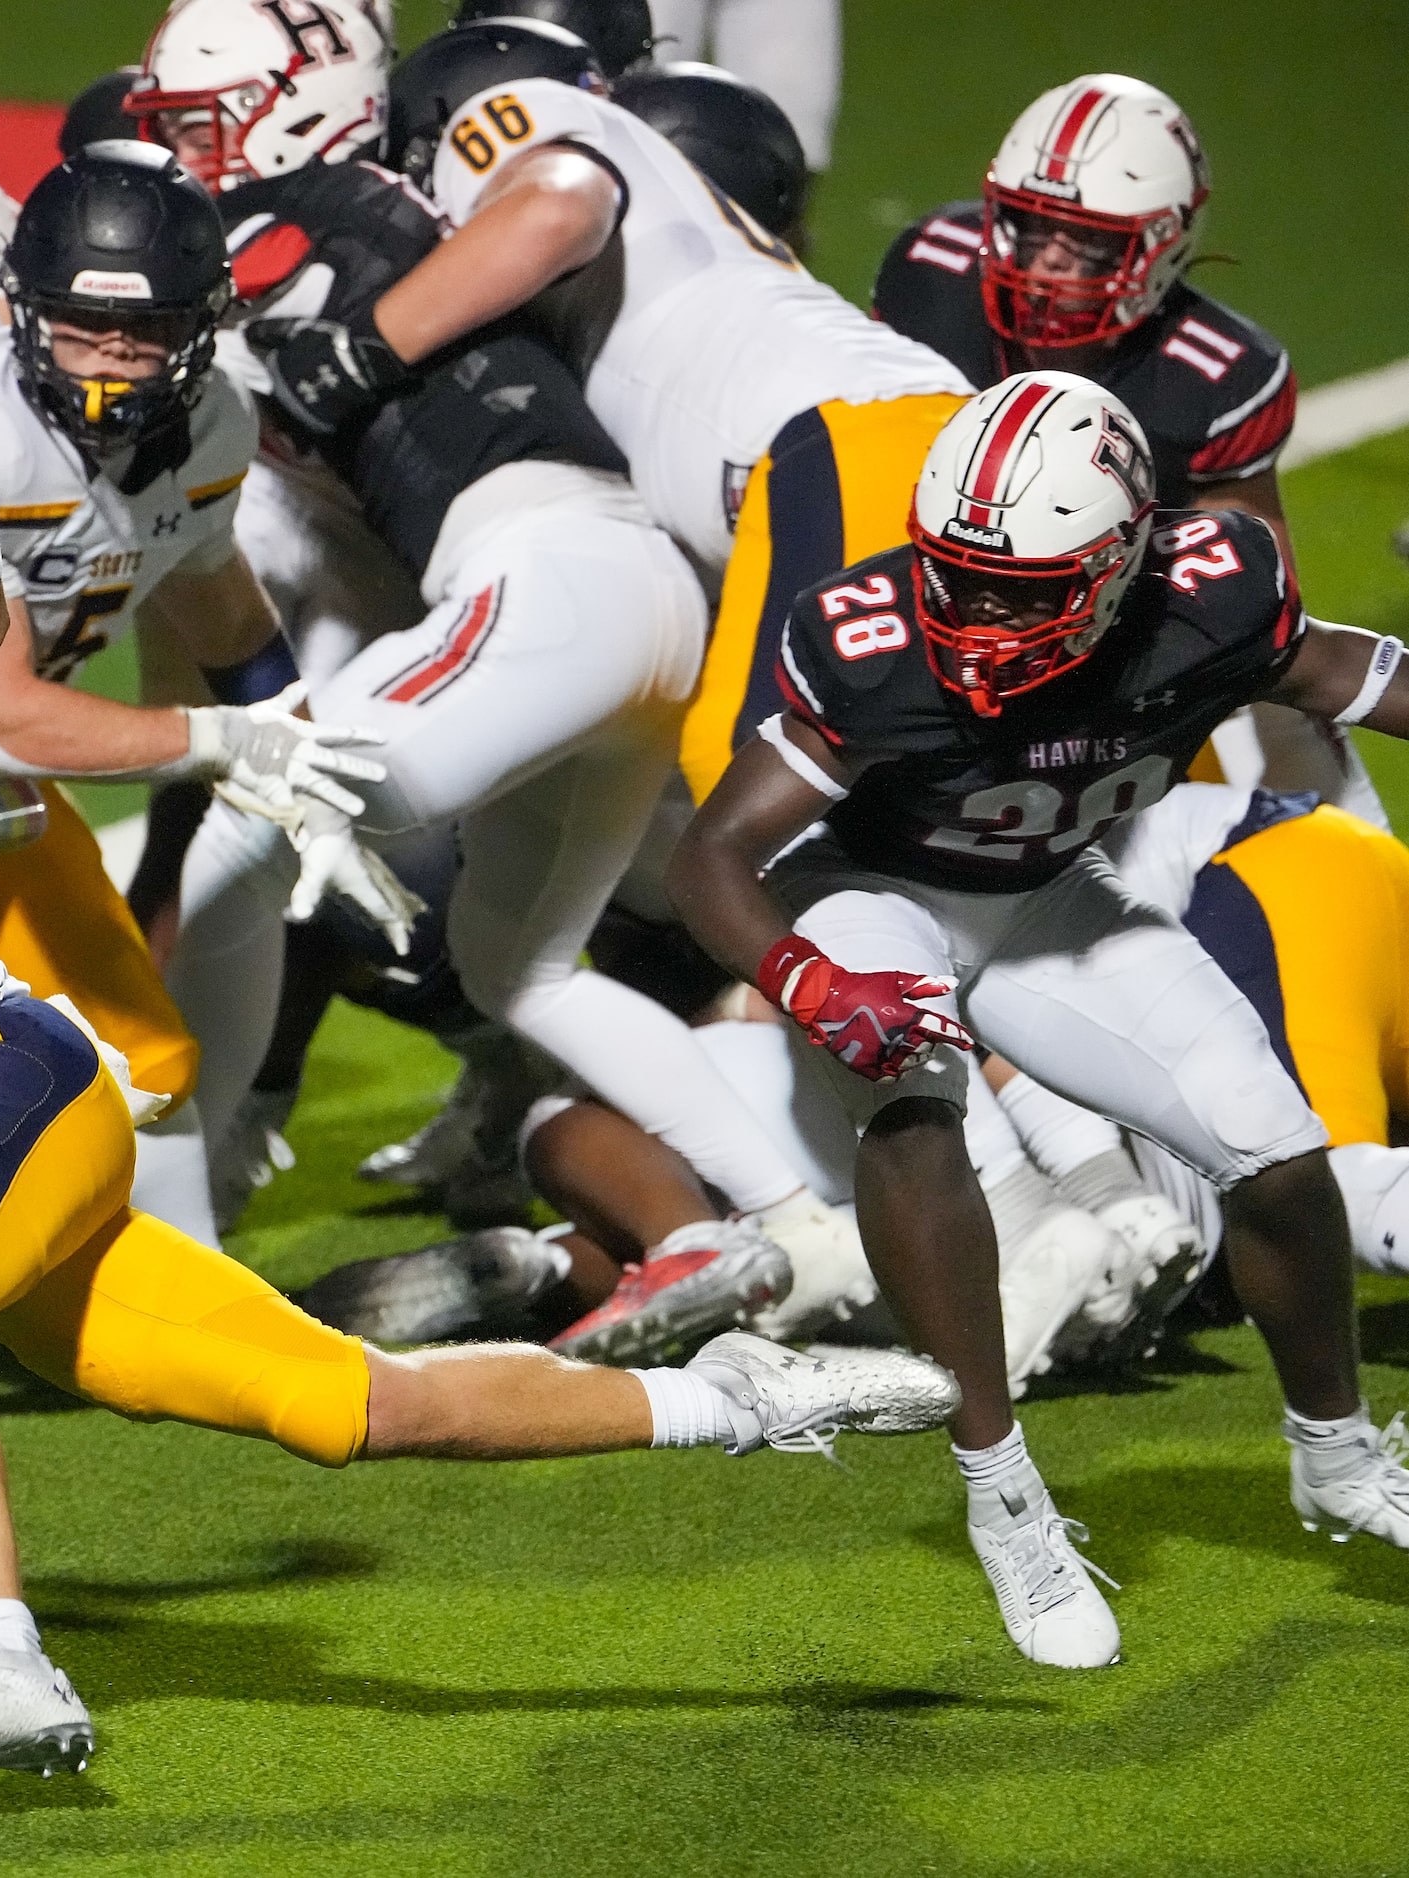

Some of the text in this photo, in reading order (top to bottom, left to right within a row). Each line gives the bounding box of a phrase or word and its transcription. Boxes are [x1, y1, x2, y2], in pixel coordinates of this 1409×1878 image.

[451, 93, 535, 175] 66
[906, 217, 984, 276] 11
[1161, 316, 1248, 382] 11
[947, 520, 1006, 548] Riddell
[1152, 517, 1244, 593] 28
[28, 551, 78, 585] C
[818, 573, 911, 662] 28
[1028, 737, 1129, 769] HAWKS
